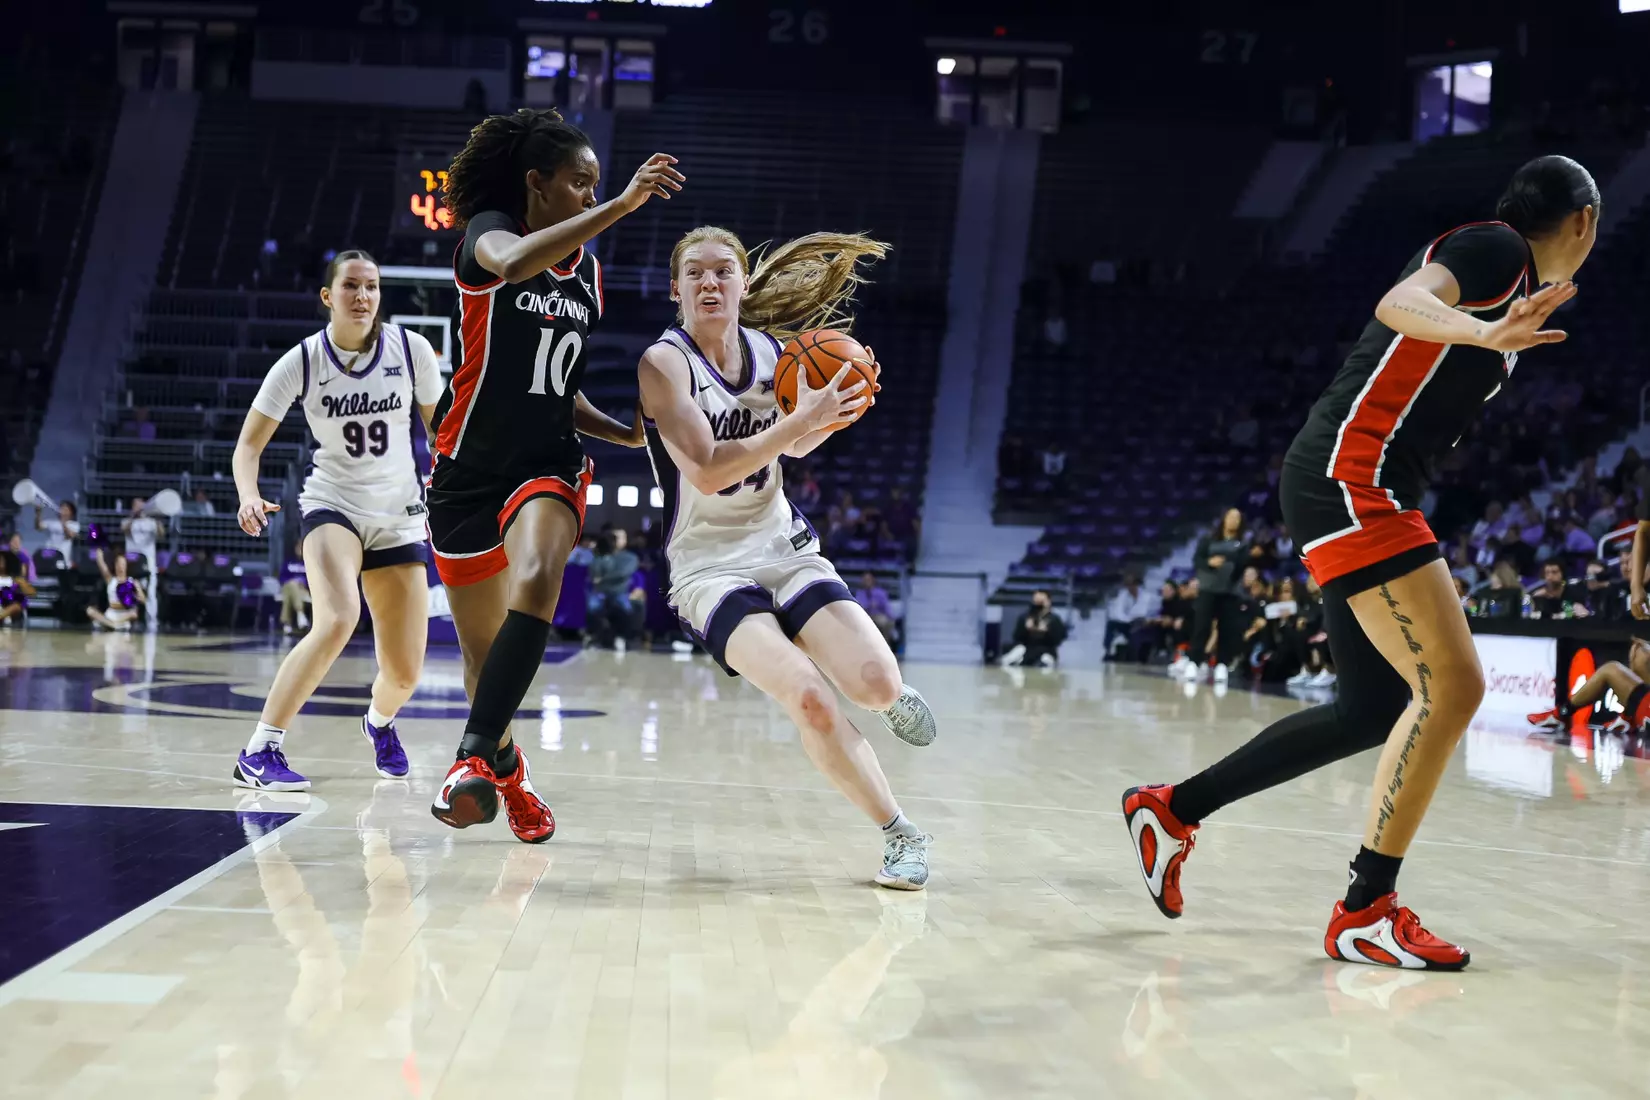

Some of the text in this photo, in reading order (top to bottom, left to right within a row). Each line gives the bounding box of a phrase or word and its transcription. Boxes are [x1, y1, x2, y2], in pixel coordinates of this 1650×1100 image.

[767, 8, 829, 45] 26
[1200, 28, 1260, 64] 27
[528, 327, 583, 397] 10
[321, 391, 402, 418] Wildcats
[342, 419, 389, 459] 99
